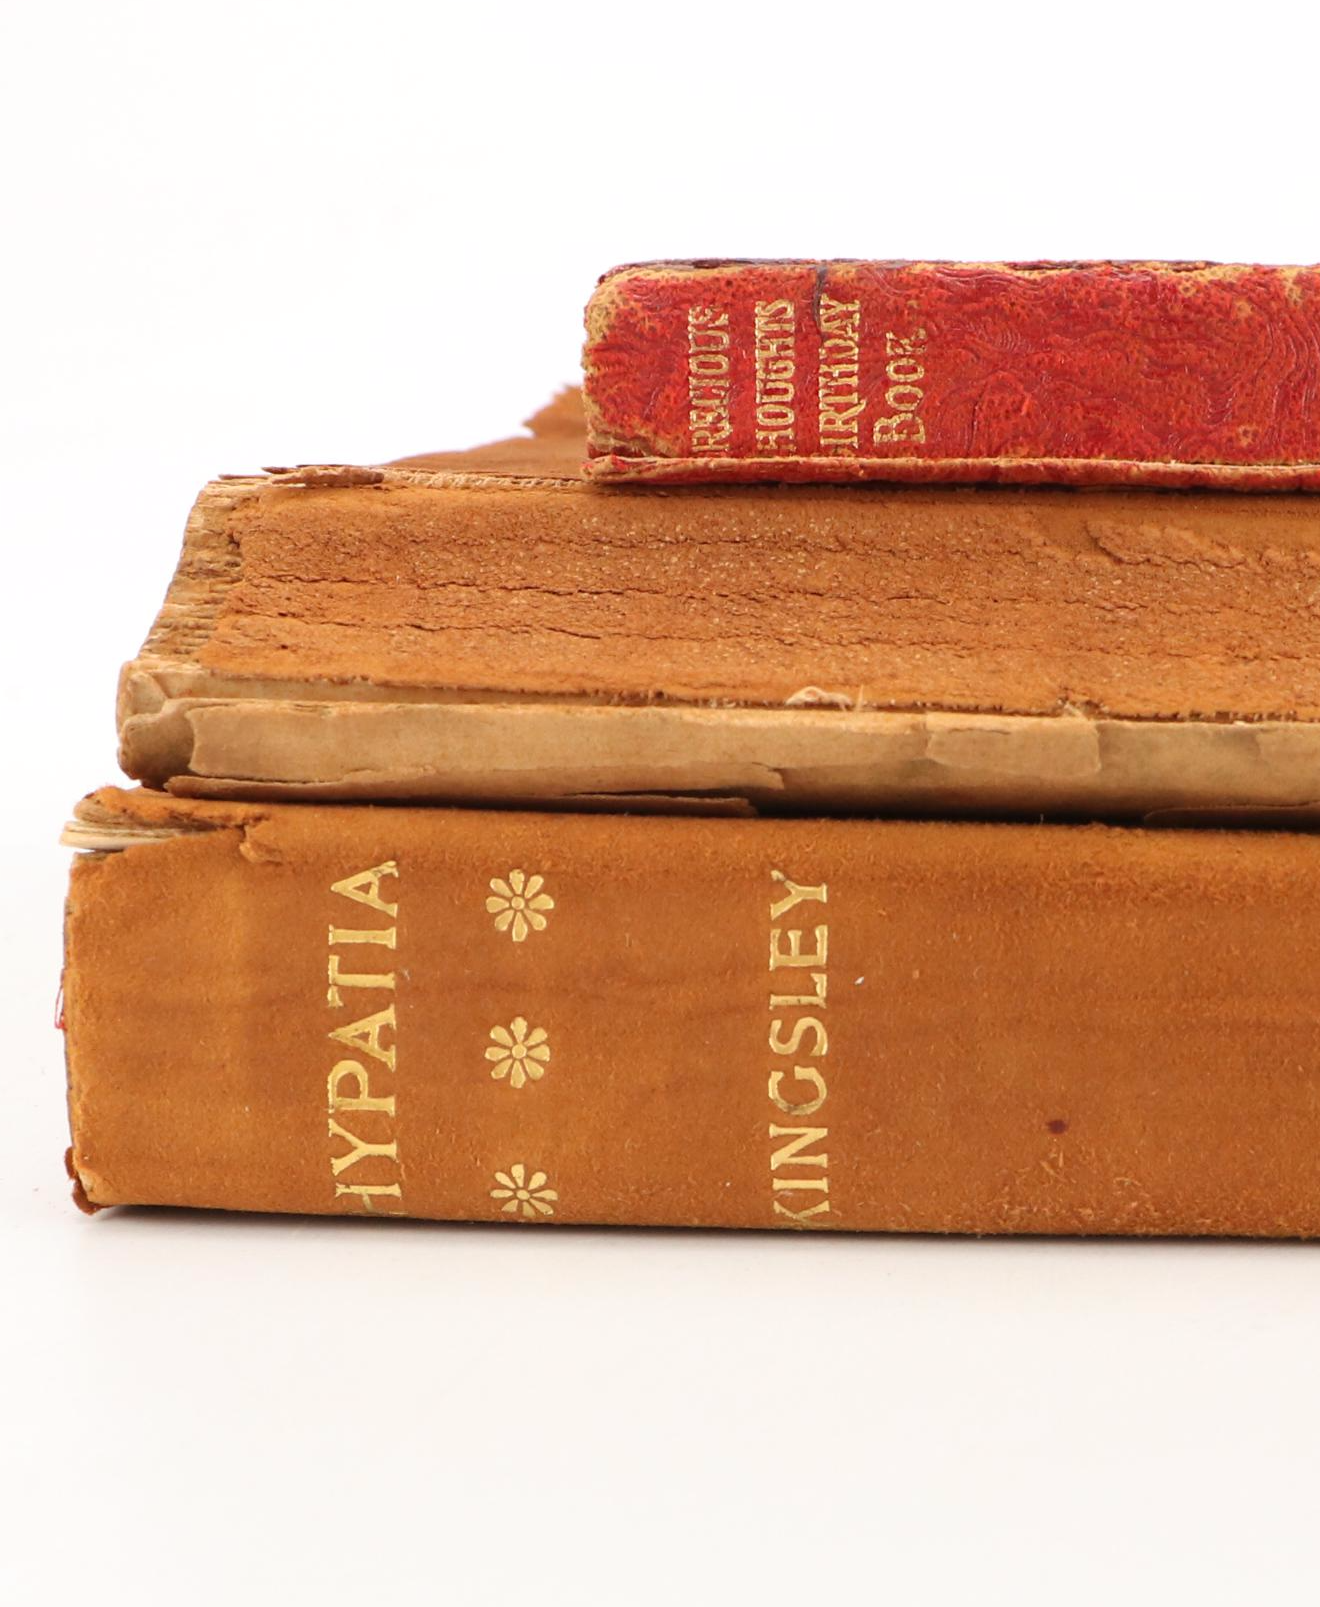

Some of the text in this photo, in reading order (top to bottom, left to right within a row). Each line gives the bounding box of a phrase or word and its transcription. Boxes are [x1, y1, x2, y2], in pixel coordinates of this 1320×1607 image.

[687, 303, 734, 454] RECIOUS
[754, 298, 797, 453] HOUGHTS
[818, 292, 868, 453] IRTHDAY
[872, 327, 927, 445] BOOK
[326, 859, 402, 1215] HYPATIA
[767, 868, 831, 1228] KINGSLEY
